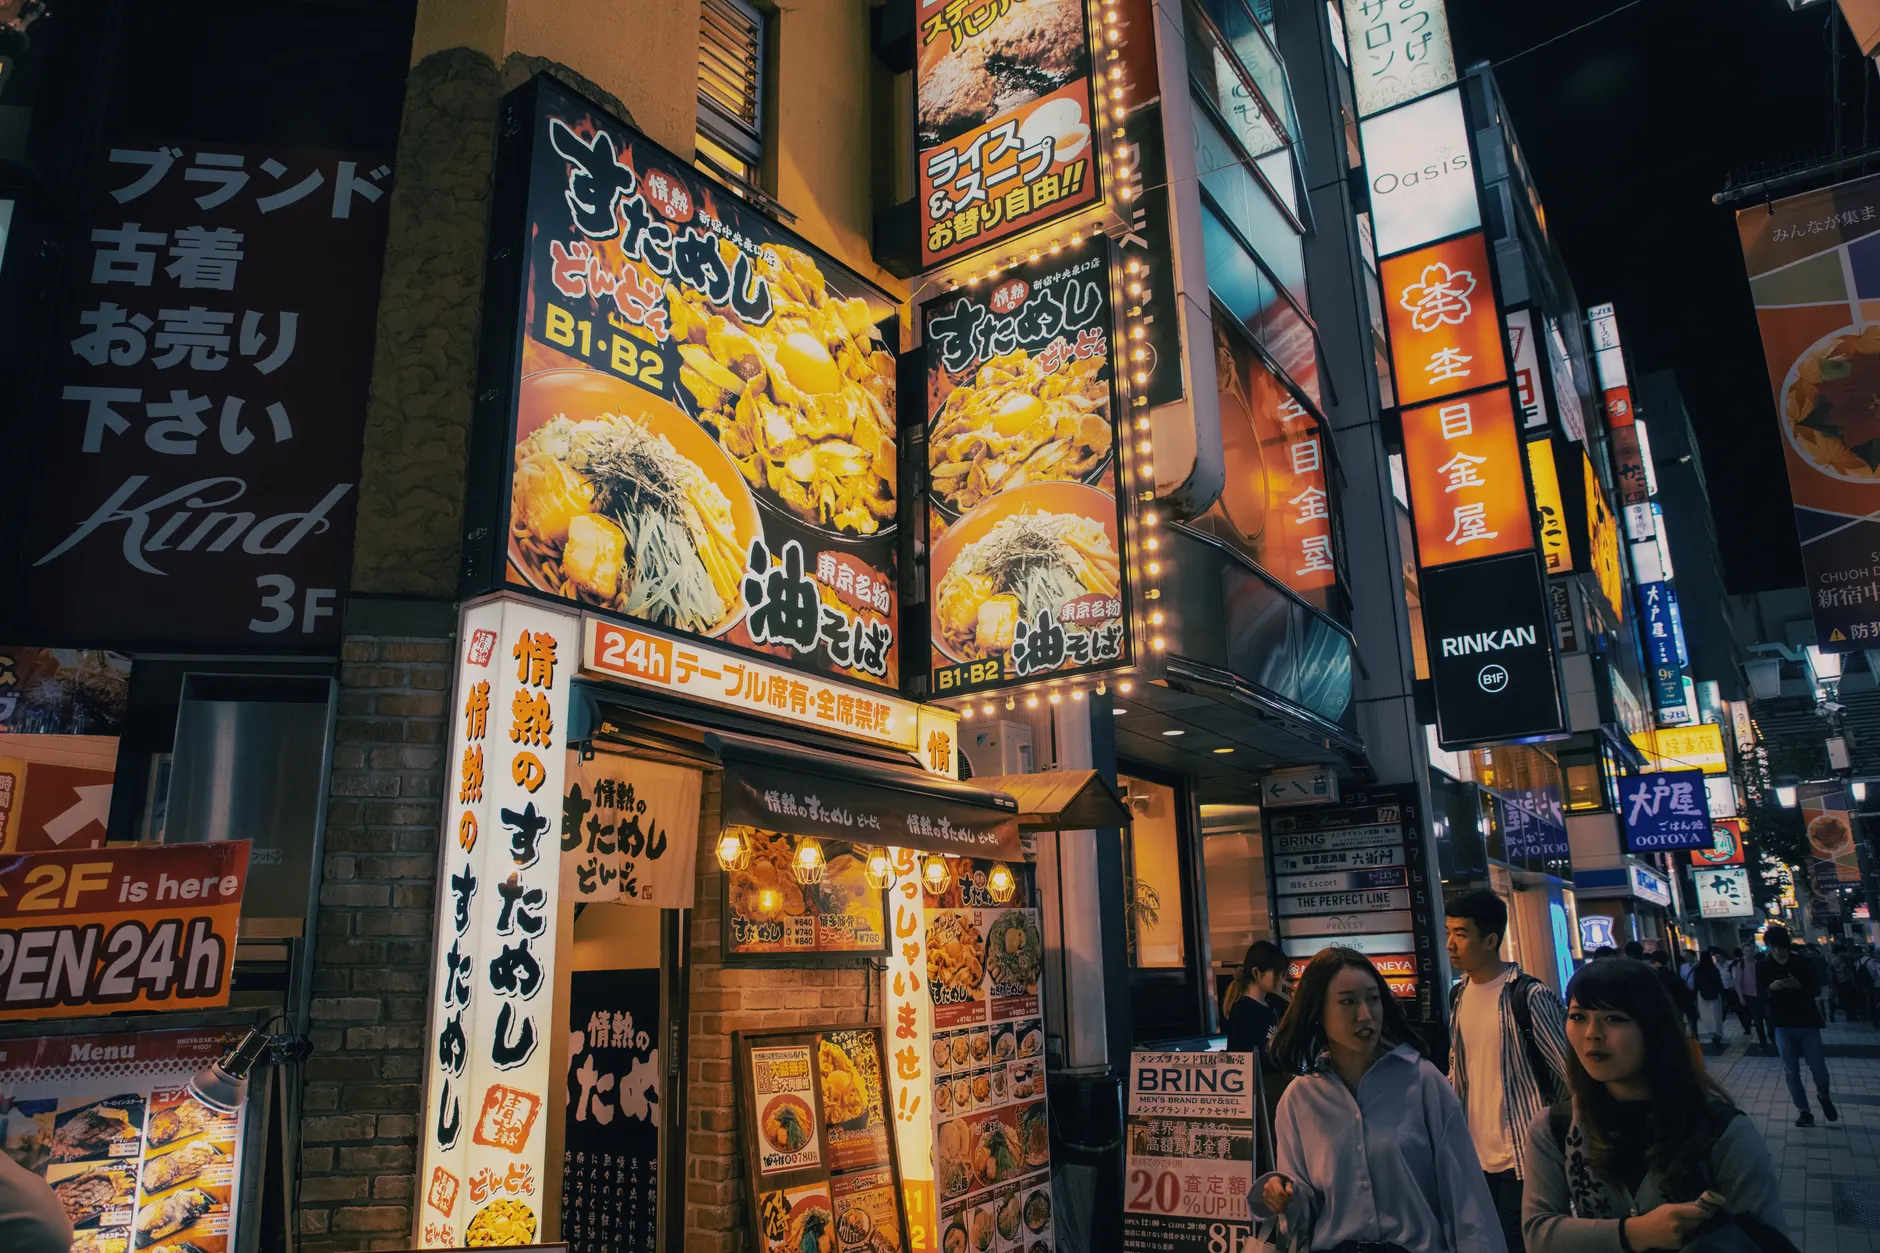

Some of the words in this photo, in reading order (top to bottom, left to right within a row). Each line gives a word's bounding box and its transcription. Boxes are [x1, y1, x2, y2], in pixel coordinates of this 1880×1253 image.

[928, 120, 1024, 188] ライス
[1373, 154, 1469, 195] Oasis
[108, 146, 391, 218] ブランド
[647, 172, 690, 220] 情熱の
[550, 118, 773, 326] すためし
[927, 158, 1089, 253] お替り自由!!
[1772, 204, 1877, 243] みんなが集ま
[91, 222, 244, 290] 古着
[549, 239, 670, 343] どんどん
[70, 302, 299, 375] お売り
[928, 278, 1103, 373] すためし
[1039, 326, 1107, 375] どんどん
[62, 385, 293, 454] 下さい
[32, 475, 353, 575] Kind
[816, 552, 891, 617] 東京名物
[1820, 567, 1869, 584] CHUOH
[248, 574, 337, 633] 3F
[742, 535, 894, 677] 油そば
[1060, 599, 1121, 622] 東京名物
[1646, 584, 1668, 639] 大戸屋
[1011, 607, 1124, 678] 油そば
[1441, 625, 1537, 657] RINKAN
[601, 631, 665, 679] 24h
[675, 650, 892, 736] テーブル席有・全席禁煙
[1482, 672, 1504, 685] B1F
[1658, 668, 1675, 681] 9F
[593, 778, 647, 815] 情熱の
[764, 789, 853, 826] 情熱のすためし
[1628, 777, 1703, 826] 大戸屋
[560, 782, 667, 861] すためし
[906, 813, 976, 844] 情熱のすためし
[1279, 834, 1326, 847] BRING
[1636, 833, 1702, 847] OOTOYA
[490, 628, 558, 1071] 情熱のすためし
[16, 861, 114, 911] 2F
[117, 875, 149, 903] is
[156, 872, 239, 901] here
[1297, 897, 1317, 908] THE
[1319, 894, 1364, 907] PERFECT
[1367, 892, 1391, 904] LINE
[437, 679, 491, 1153] 情熱のすためし
[731, 914, 782, 942] すためし
[793, 918, 813, 927] ¥640
[794, 927, 813, 936] ¥740
[819, 929, 855, 943] ラーメン
[99, 921, 219, 995] 24h
[794, 937, 813, 946] ¥840
[858, 933, 880, 943] ¥760
[930, 976, 968, 1005] すためし
[587, 1009, 650, 1051] 情熱の
[68, 1044, 136, 1063] Menu
[1137, 1068, 1245, 1093] BRING
[1136, 1105, 1247, 1115] メンズブランド・アクセサリー
[468, 1163, 535, 1204] どんどん
[1128, 1169, 1181, 1213] 20
[1183, 1174, 1248, 1196] 査定額
[1141, 1217, 1160, 1227] 12:00
[1187, 1222, 1207, 1231] 20:00
